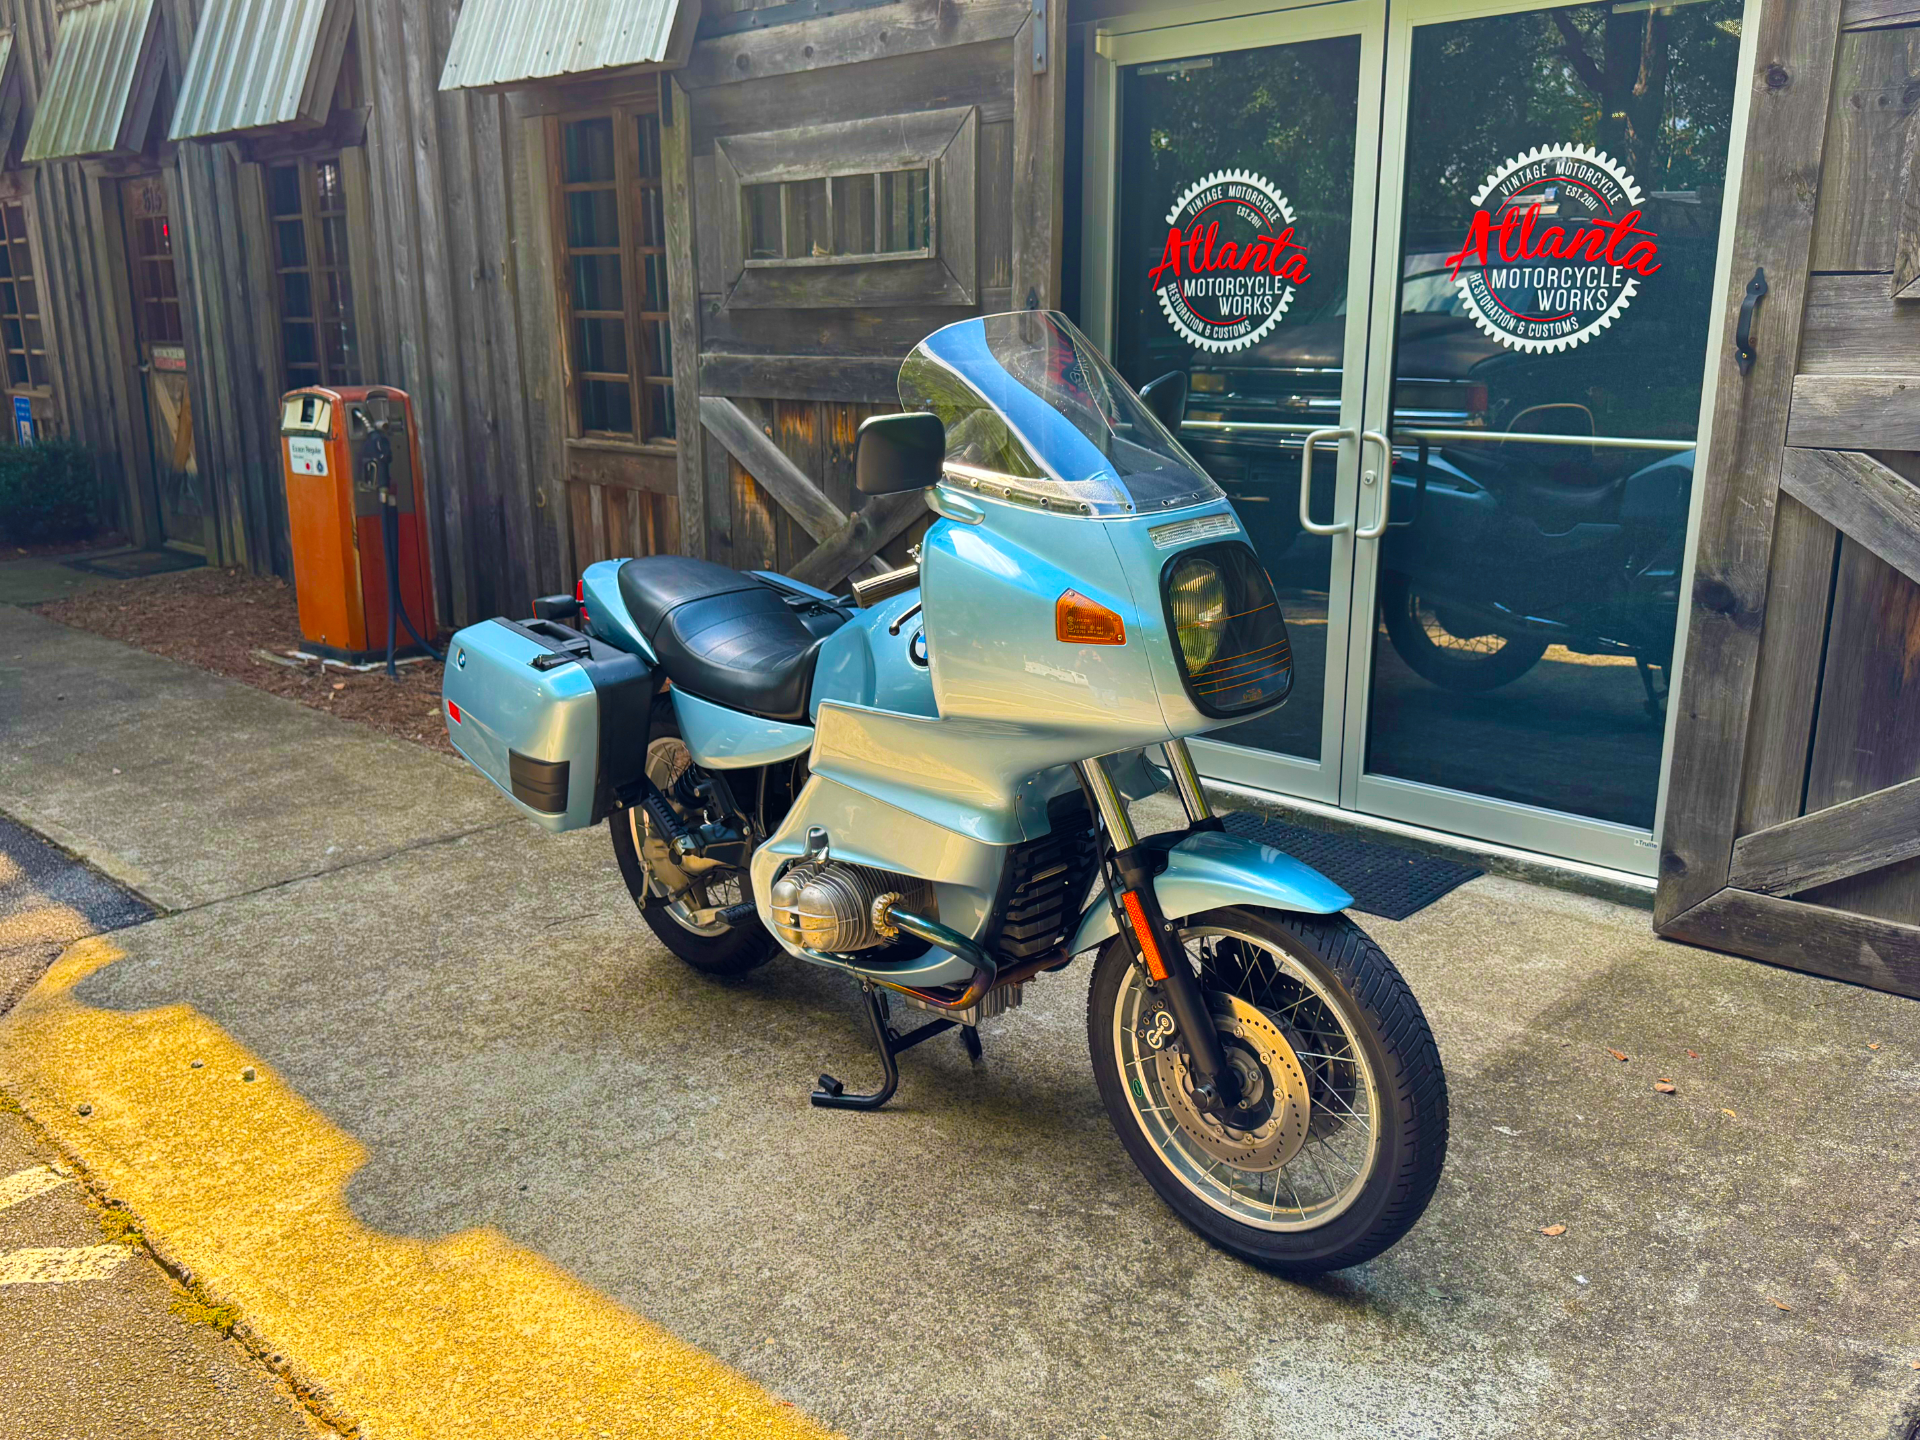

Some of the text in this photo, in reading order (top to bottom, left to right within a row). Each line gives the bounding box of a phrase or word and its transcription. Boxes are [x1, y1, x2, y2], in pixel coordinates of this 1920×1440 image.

[1186, 184, 1281, 224] VINTAGE MOTORCYCLE
[1499, 161, 1623, 206] VINTAGE MOTORCYCLE
[1148, 220, 1311, 292] Atlanta
[1444, 202, 1662, 283] Atlanta
[1184, 275, 1283, 297] MOTORCYCLE
[1491, 265, 1624, 289] MOTORCYCLE
[1166, 282, 1252, 340] RESTORATION & CUSTOMS
[1219, 295, 1273, 316] WORKS
[1469, 272, 1580, 338] RESTORATION & CUSTOMS
[1537, 288, 1609, 311] WORKS
